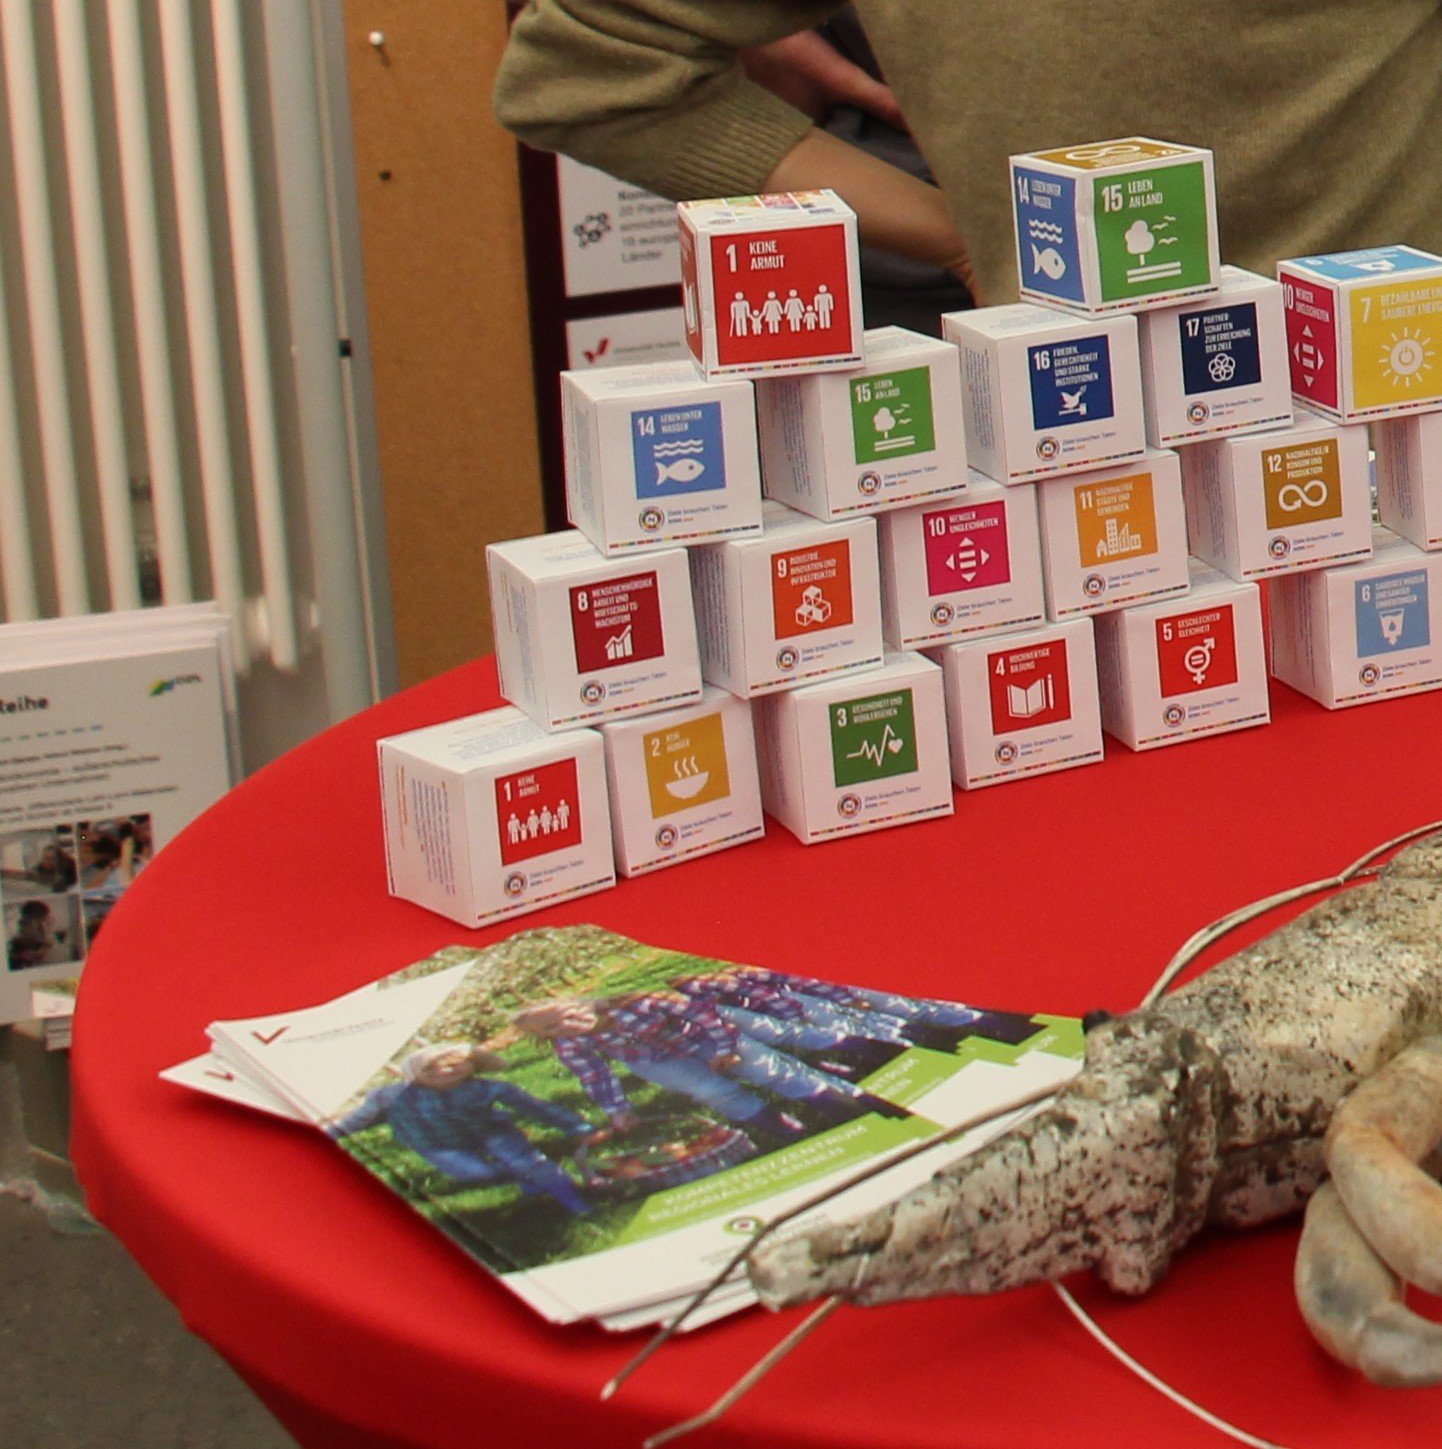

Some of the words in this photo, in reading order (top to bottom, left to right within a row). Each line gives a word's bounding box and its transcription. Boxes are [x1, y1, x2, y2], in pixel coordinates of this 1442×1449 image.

[1017, 176, 1030, 205] 14
[1101, 184, 1124, 213] 15
[1128, 179, 1153, 194] LEBEN
[725, 243, 738, 273] 1
[749, 240, 777, 254] KEINE
[750, 255, 785, 271] ARMUT
[1283, 282, 1294, 310] 10
[1360, 296, 1373, 323] 7
[1186, 318, 1200, 337] 17
[1033, 350, 1050, 371] 16
[855, 383, 872, 403] 15
[637, 416, 655, 437] 14
[1267, 455, 1283, 474] 12
[1080, 491, 1094, 509] 11
[928, 517, 946, 537] 10
[777, 559, 788, 578] 9
[577, 591, 589, 612] 8
[1361, 584, 1371, 602] 6
[1162, 622, 1173, 641] 5
[996, 657, 1006, 676] 4
[837, 708, 848, 727] 3
[651, 738, 661, 757] 2
[503, 781, 512, 802] 1
